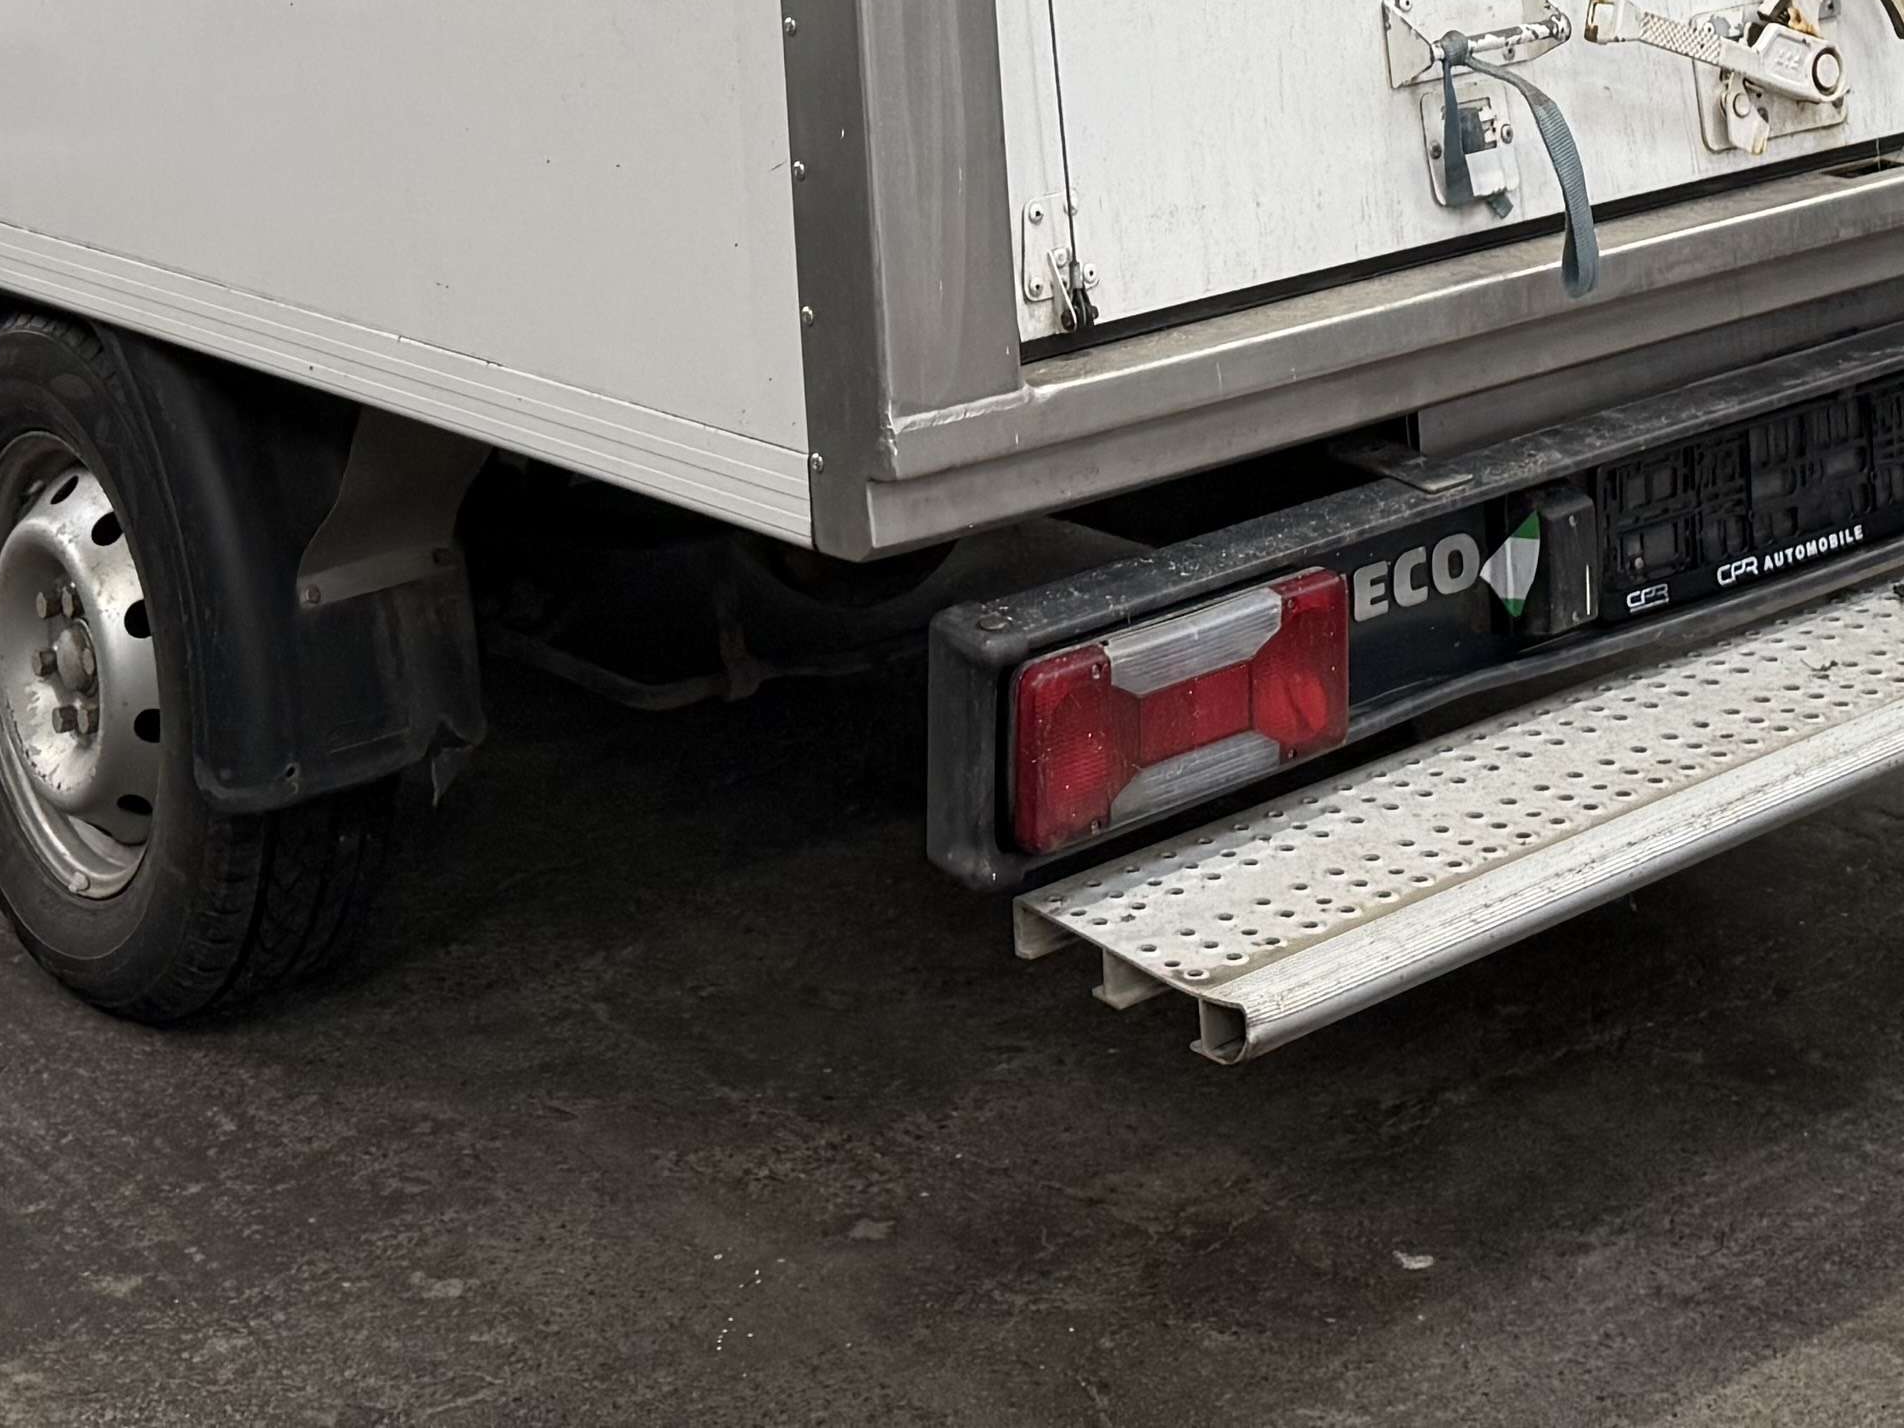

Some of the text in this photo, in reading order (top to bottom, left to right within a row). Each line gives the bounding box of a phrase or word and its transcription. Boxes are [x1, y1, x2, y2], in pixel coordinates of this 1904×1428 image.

[1353, 533, 1480, 622] ECO
[1717, 525, 1864, 586] CPR AUTOMOBILE
[1626, 583, 1669, 608] CPR
